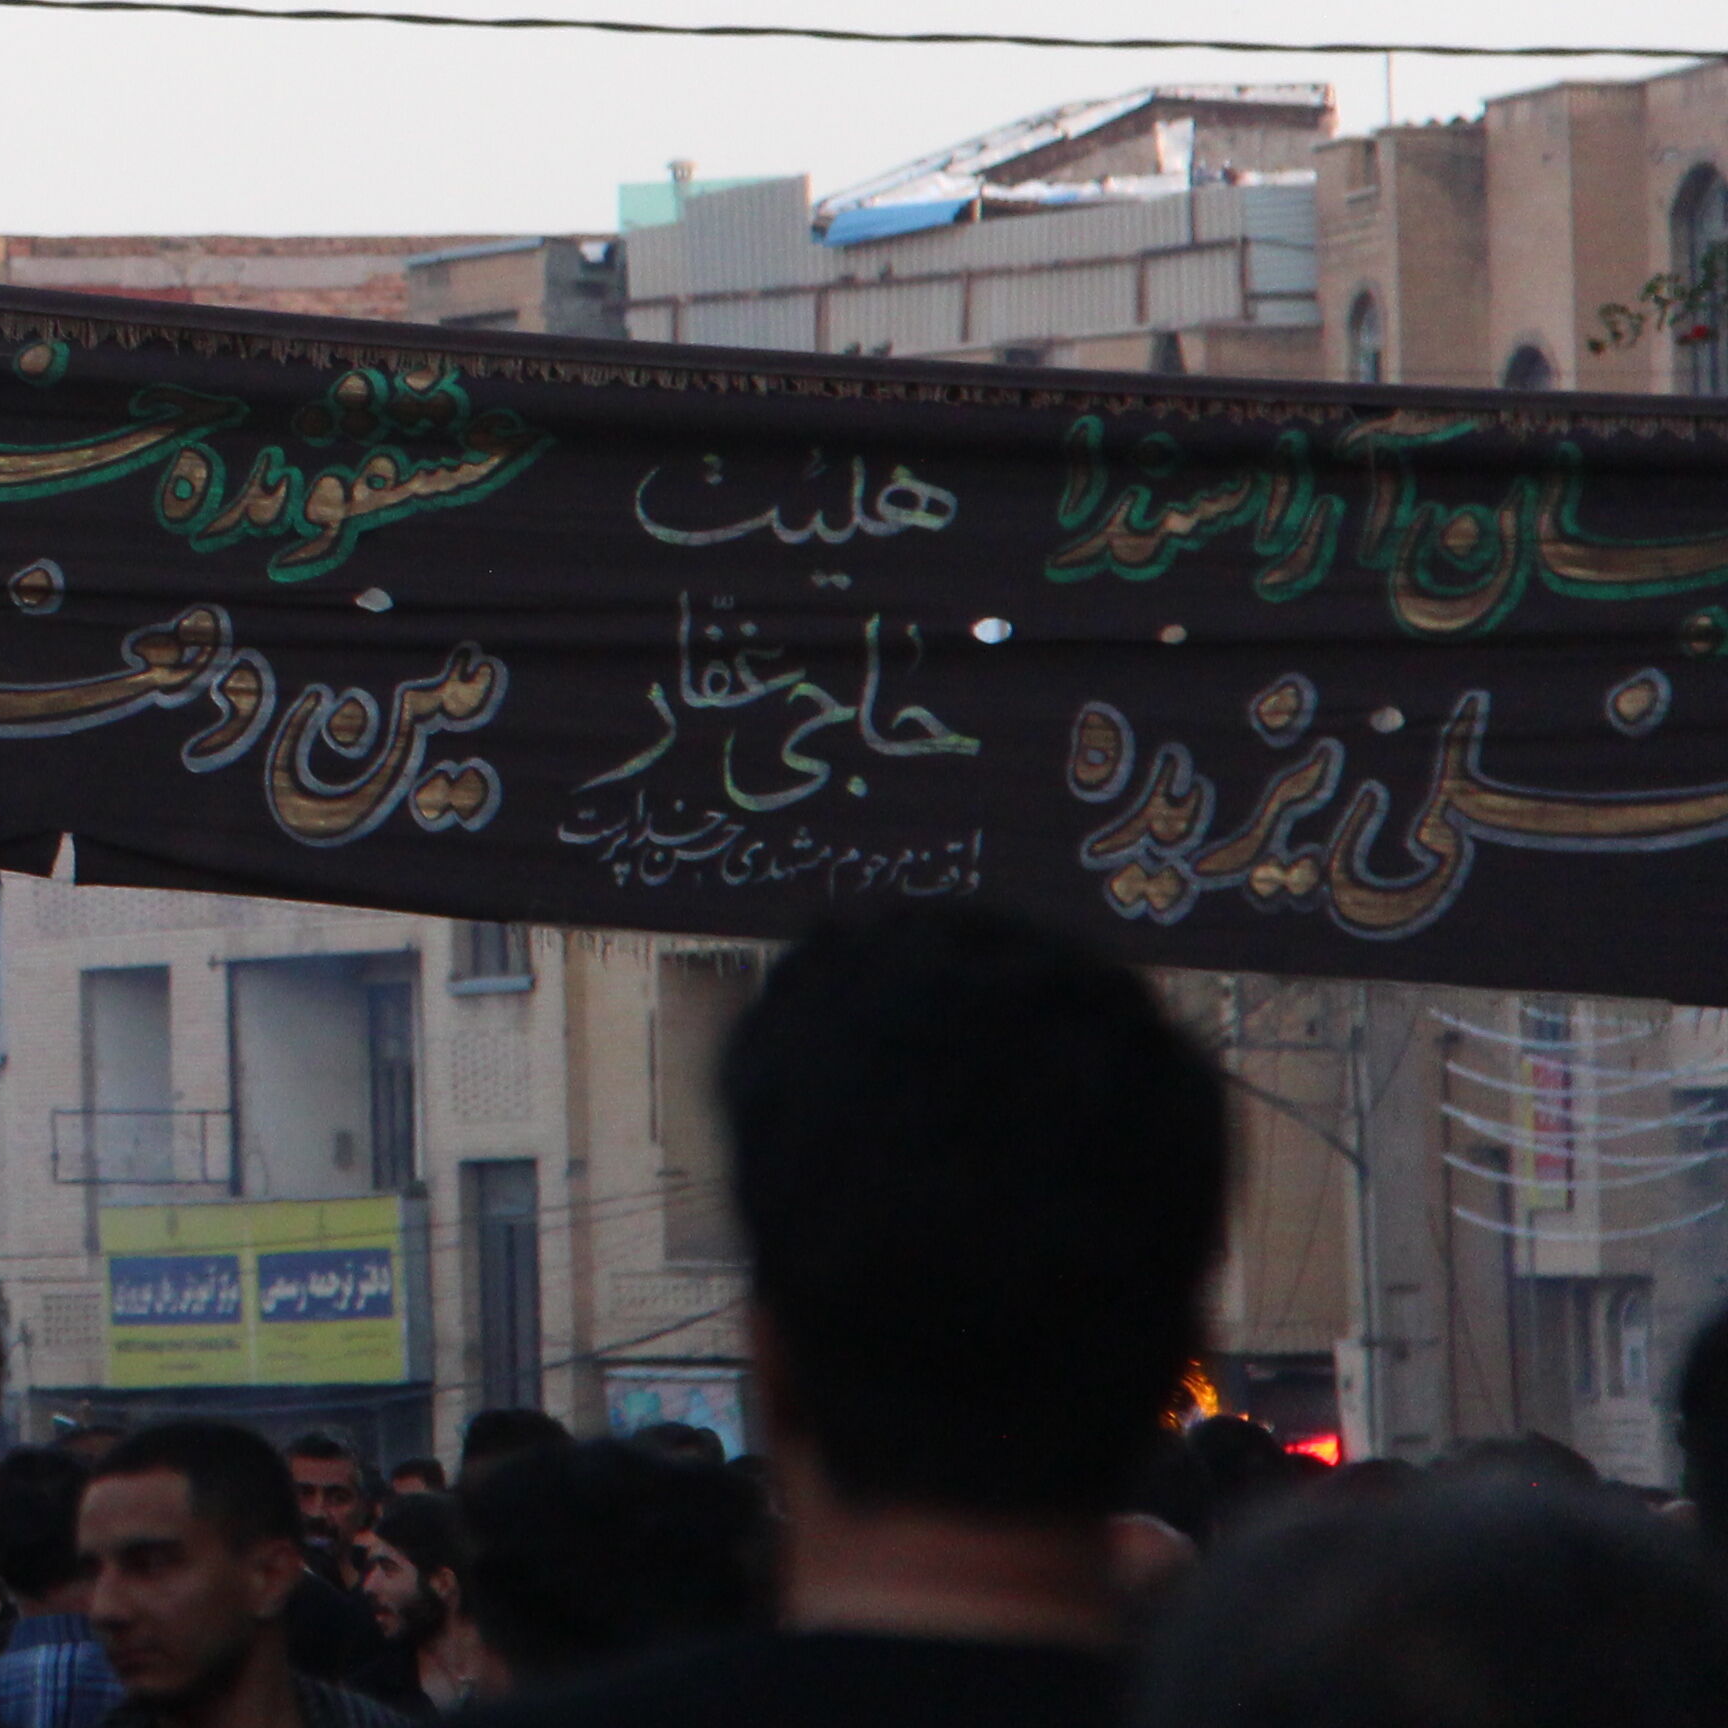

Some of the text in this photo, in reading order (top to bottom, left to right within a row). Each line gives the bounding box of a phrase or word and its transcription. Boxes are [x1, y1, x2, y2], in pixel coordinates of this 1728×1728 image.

[265, 640, 510, 846] مین
[723, 612, 980, 814] حاجی
[721, 825, 833, 887] مشهدی
[829, 845, 913, 902] مرحوم
